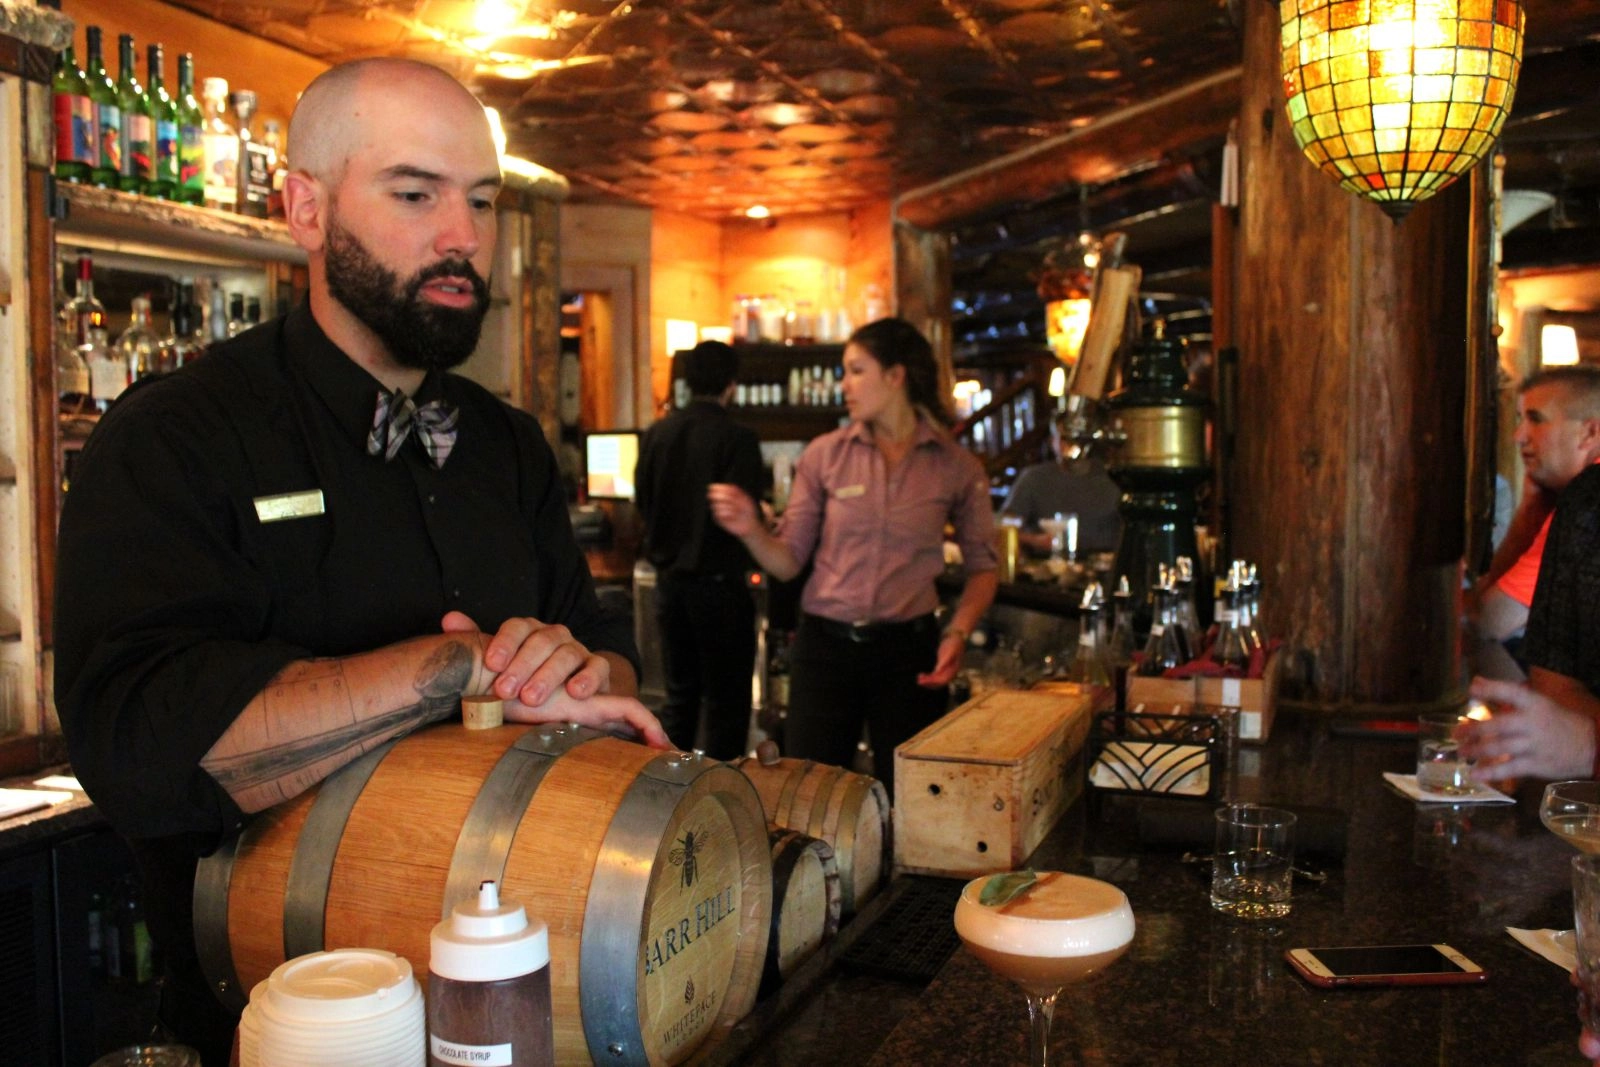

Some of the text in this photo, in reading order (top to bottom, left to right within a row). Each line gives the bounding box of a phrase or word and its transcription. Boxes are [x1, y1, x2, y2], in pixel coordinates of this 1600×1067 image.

[695, 886, 736, 939] HILL
[438, 1044, 491, 1061] CHOCOLATE SYRUP
